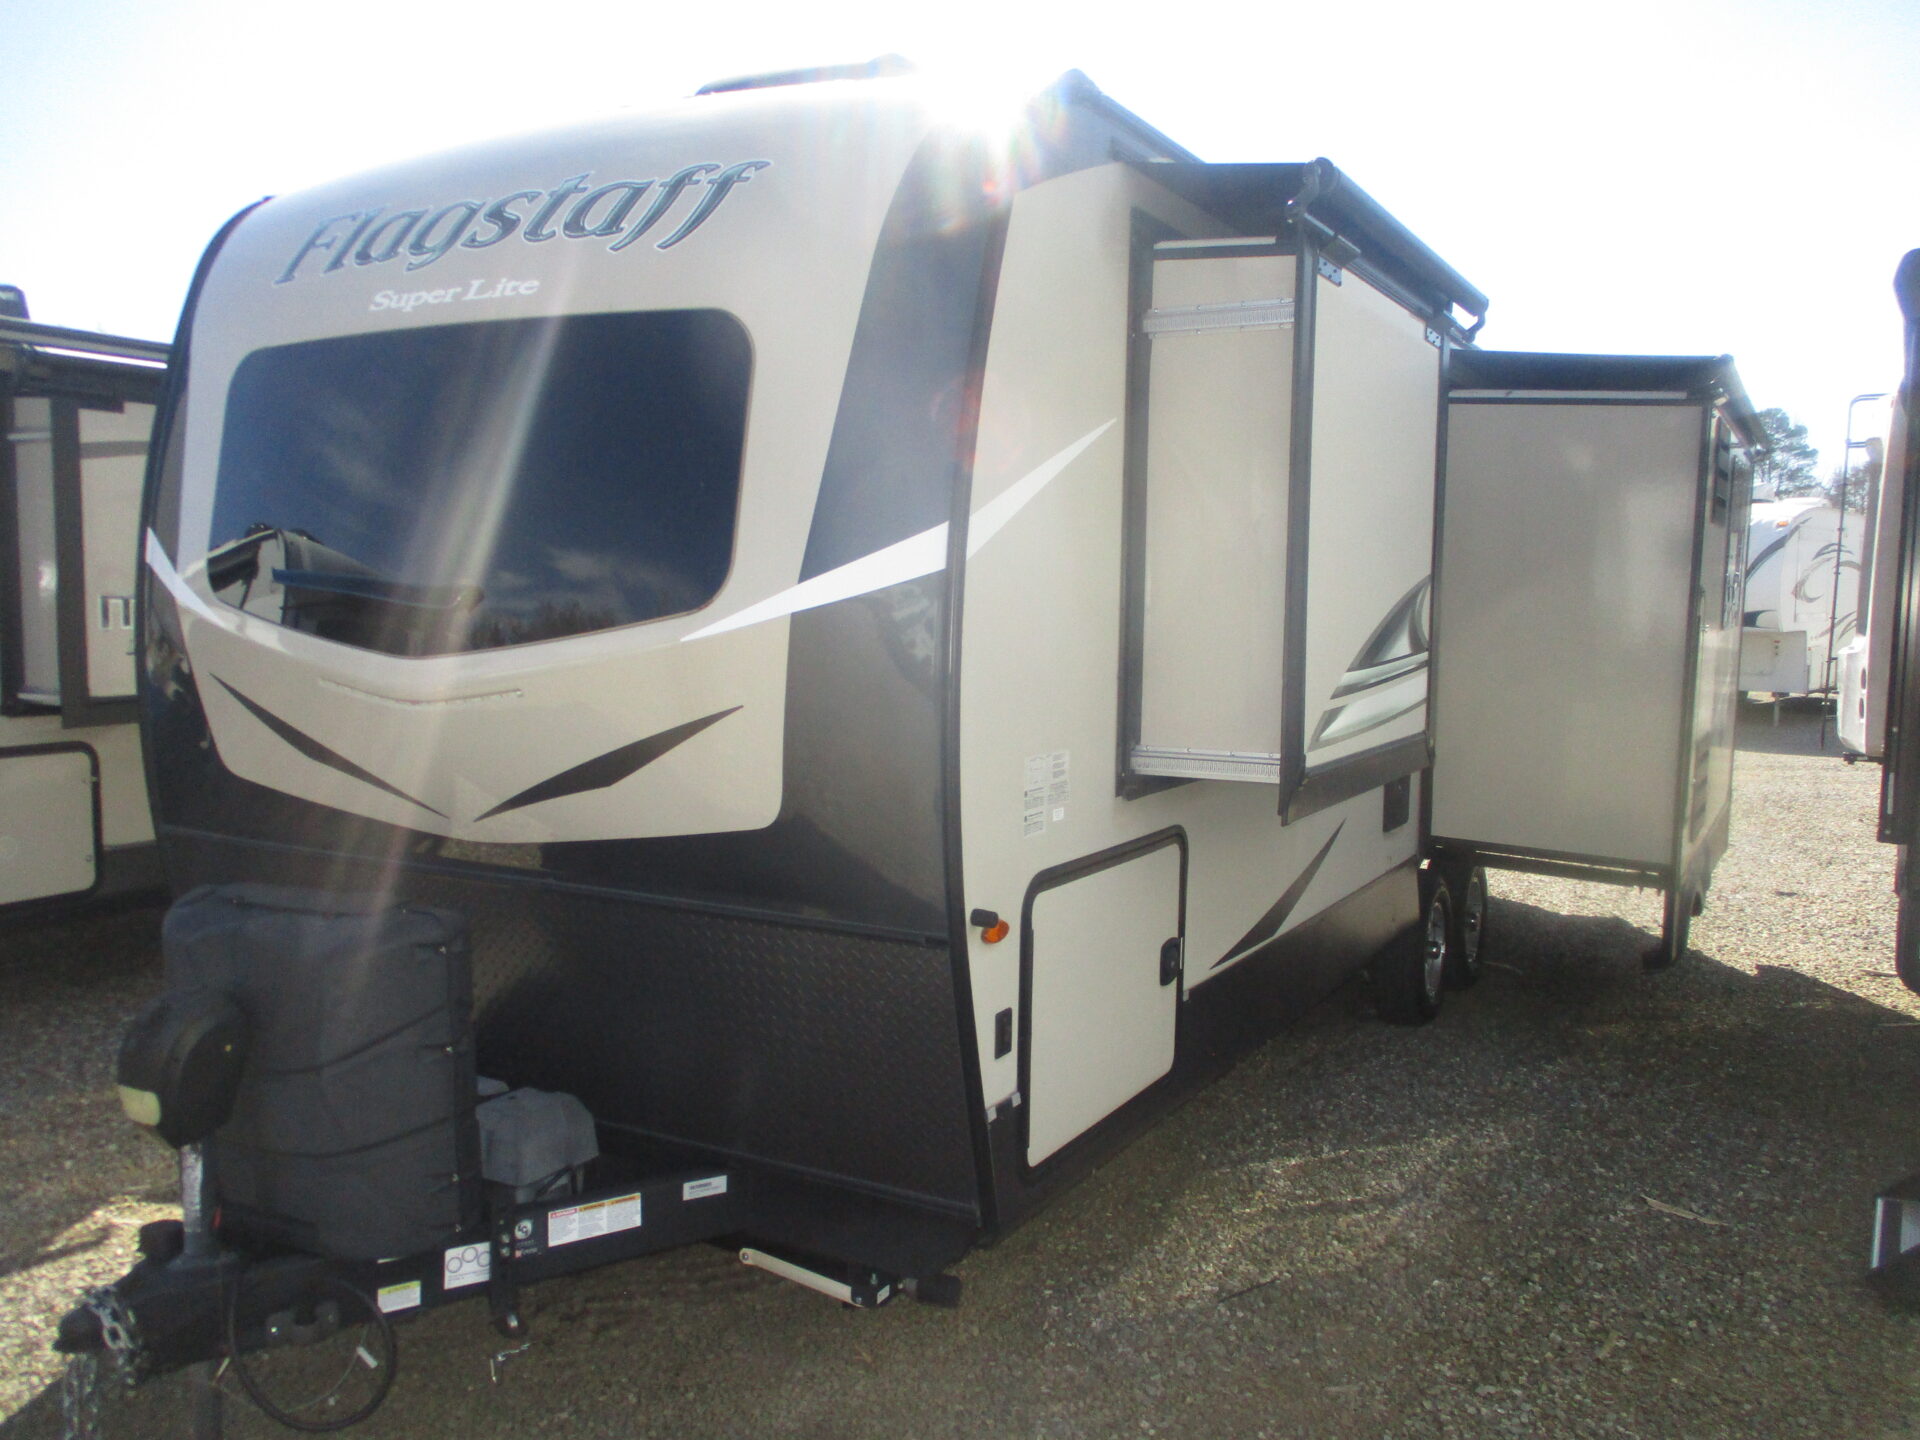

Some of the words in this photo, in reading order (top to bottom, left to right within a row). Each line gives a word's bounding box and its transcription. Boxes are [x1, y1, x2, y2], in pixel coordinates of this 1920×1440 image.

[274, 160, 771, 284] Flagstaff
[369, 287, 462, 312] Super
[462, 277, 541, 301] Lite
